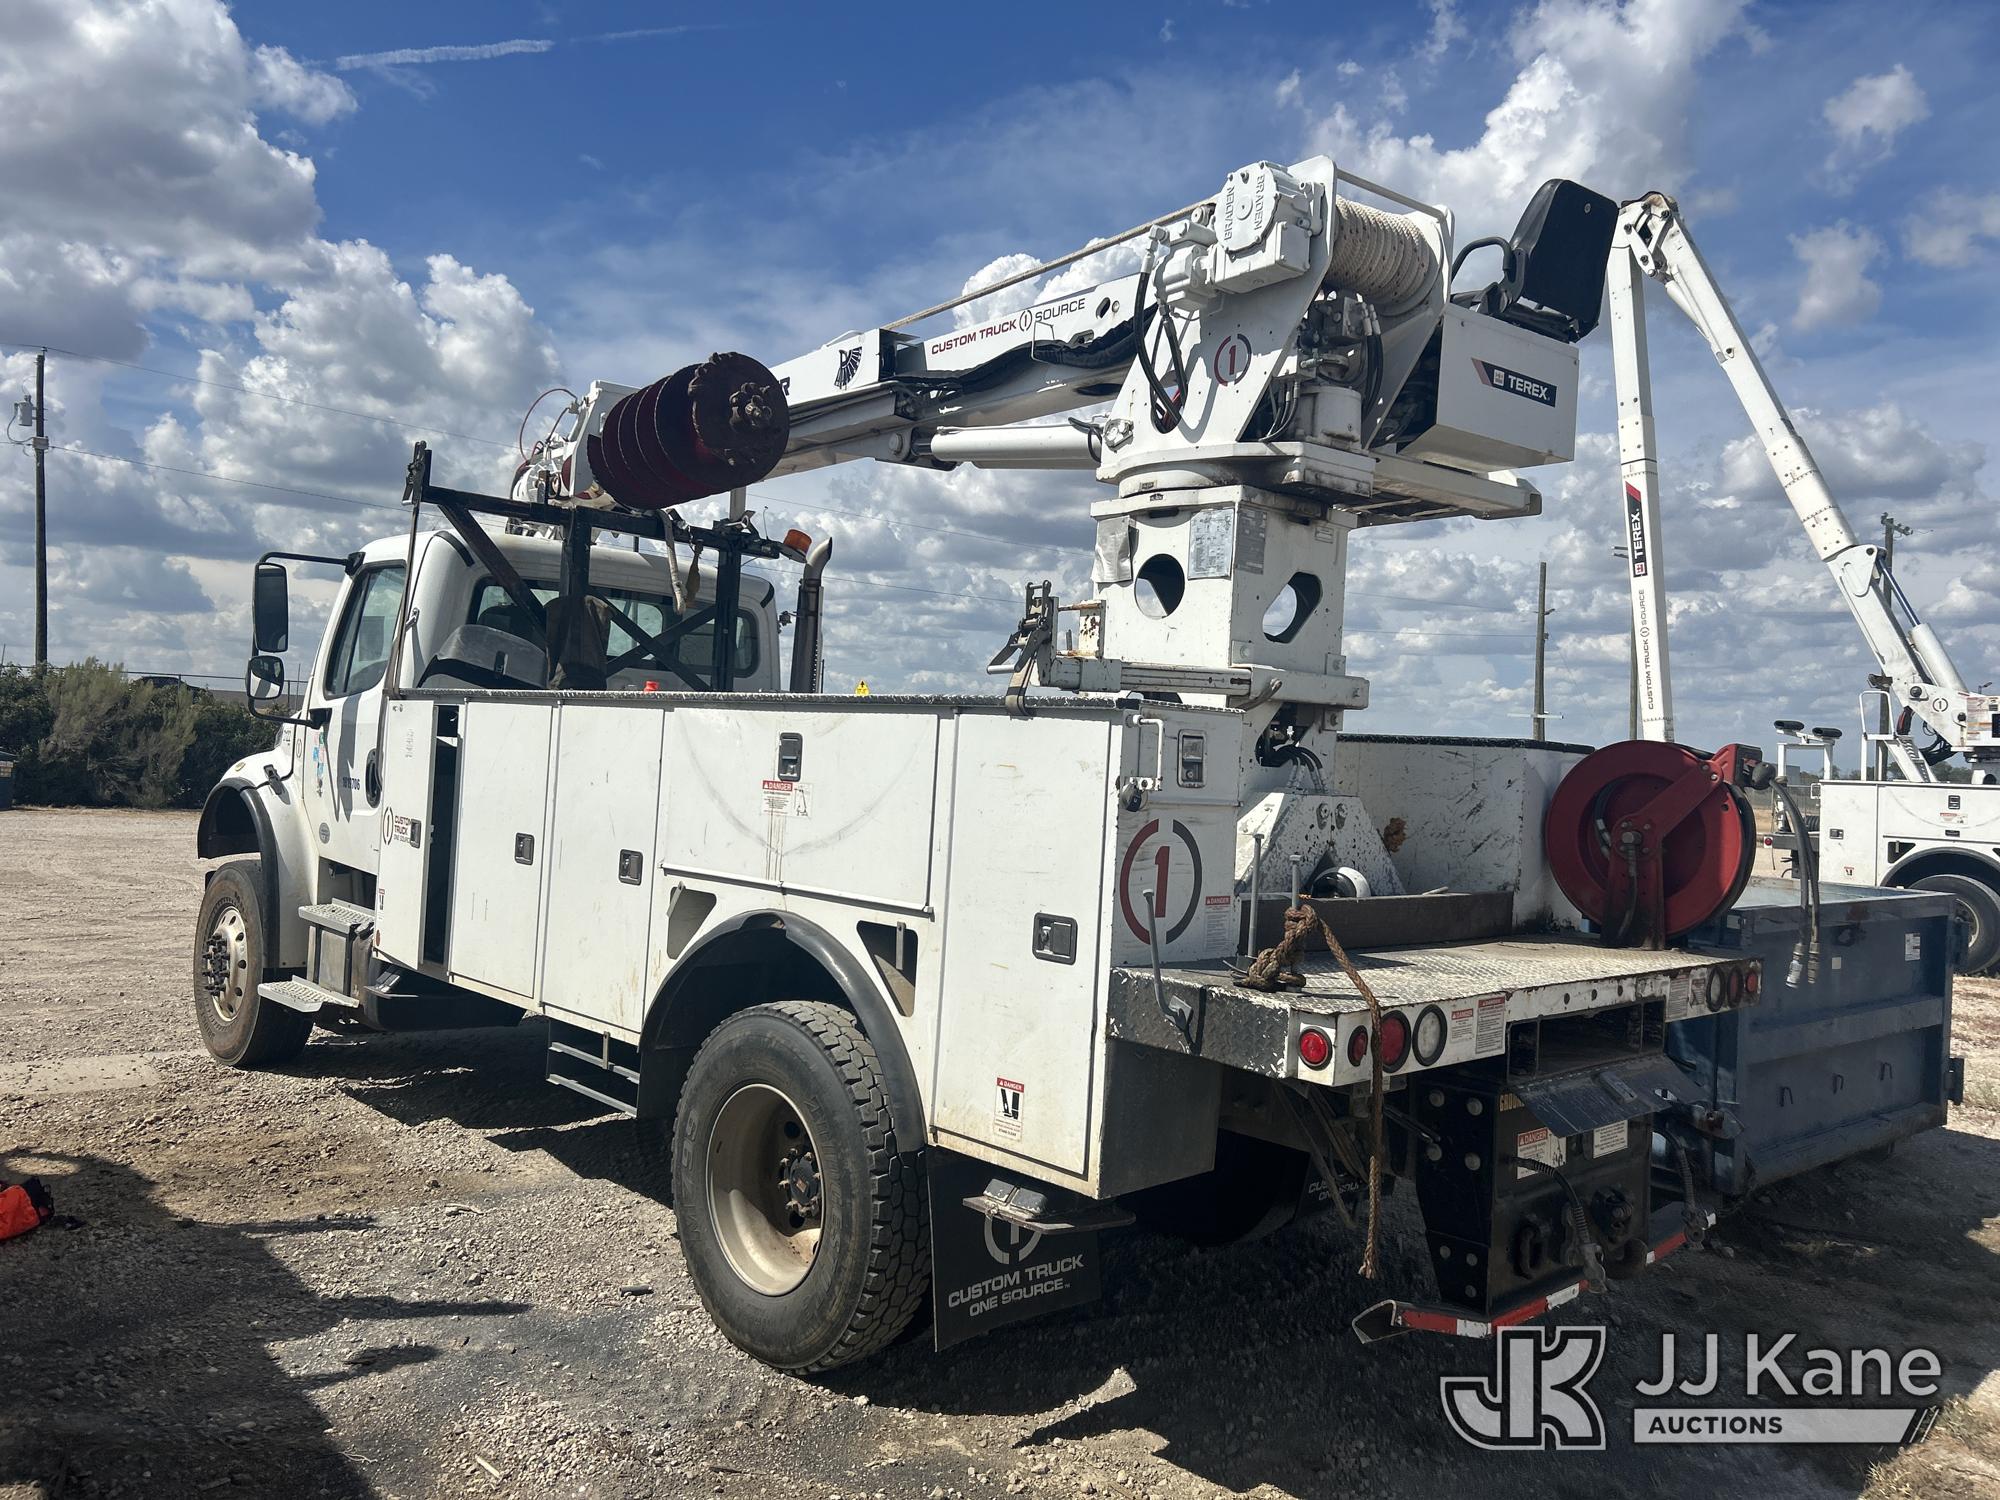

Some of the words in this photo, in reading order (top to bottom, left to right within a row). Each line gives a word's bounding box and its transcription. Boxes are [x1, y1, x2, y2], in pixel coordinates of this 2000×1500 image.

[1254, 174, 1265, 231] BRADEN
[931, 332, 977, 355] CUSTOM
[979, 319, 1017, 340] TRUCK
[1035, 298, 1086, 322] SOURCE
[1508, 374, 1548, 400] TEREX
[1632, 512, 1644, 559] TEREX
[1638, 589, 1648, 626] SOURCE
[1642, 639, 1650, 669] TRUCK
[1645, 671, 1654, 710] CUSTOM
[1155, 846, 1170, 918] 1
[1525, 1130, 1547, 1144] DANGER
[949, 1271, 1020, 1308] CUSTOM
[1025, 1254, 1085, 1281] TRUCK
[969, 1296, 998, 1317] ONE
